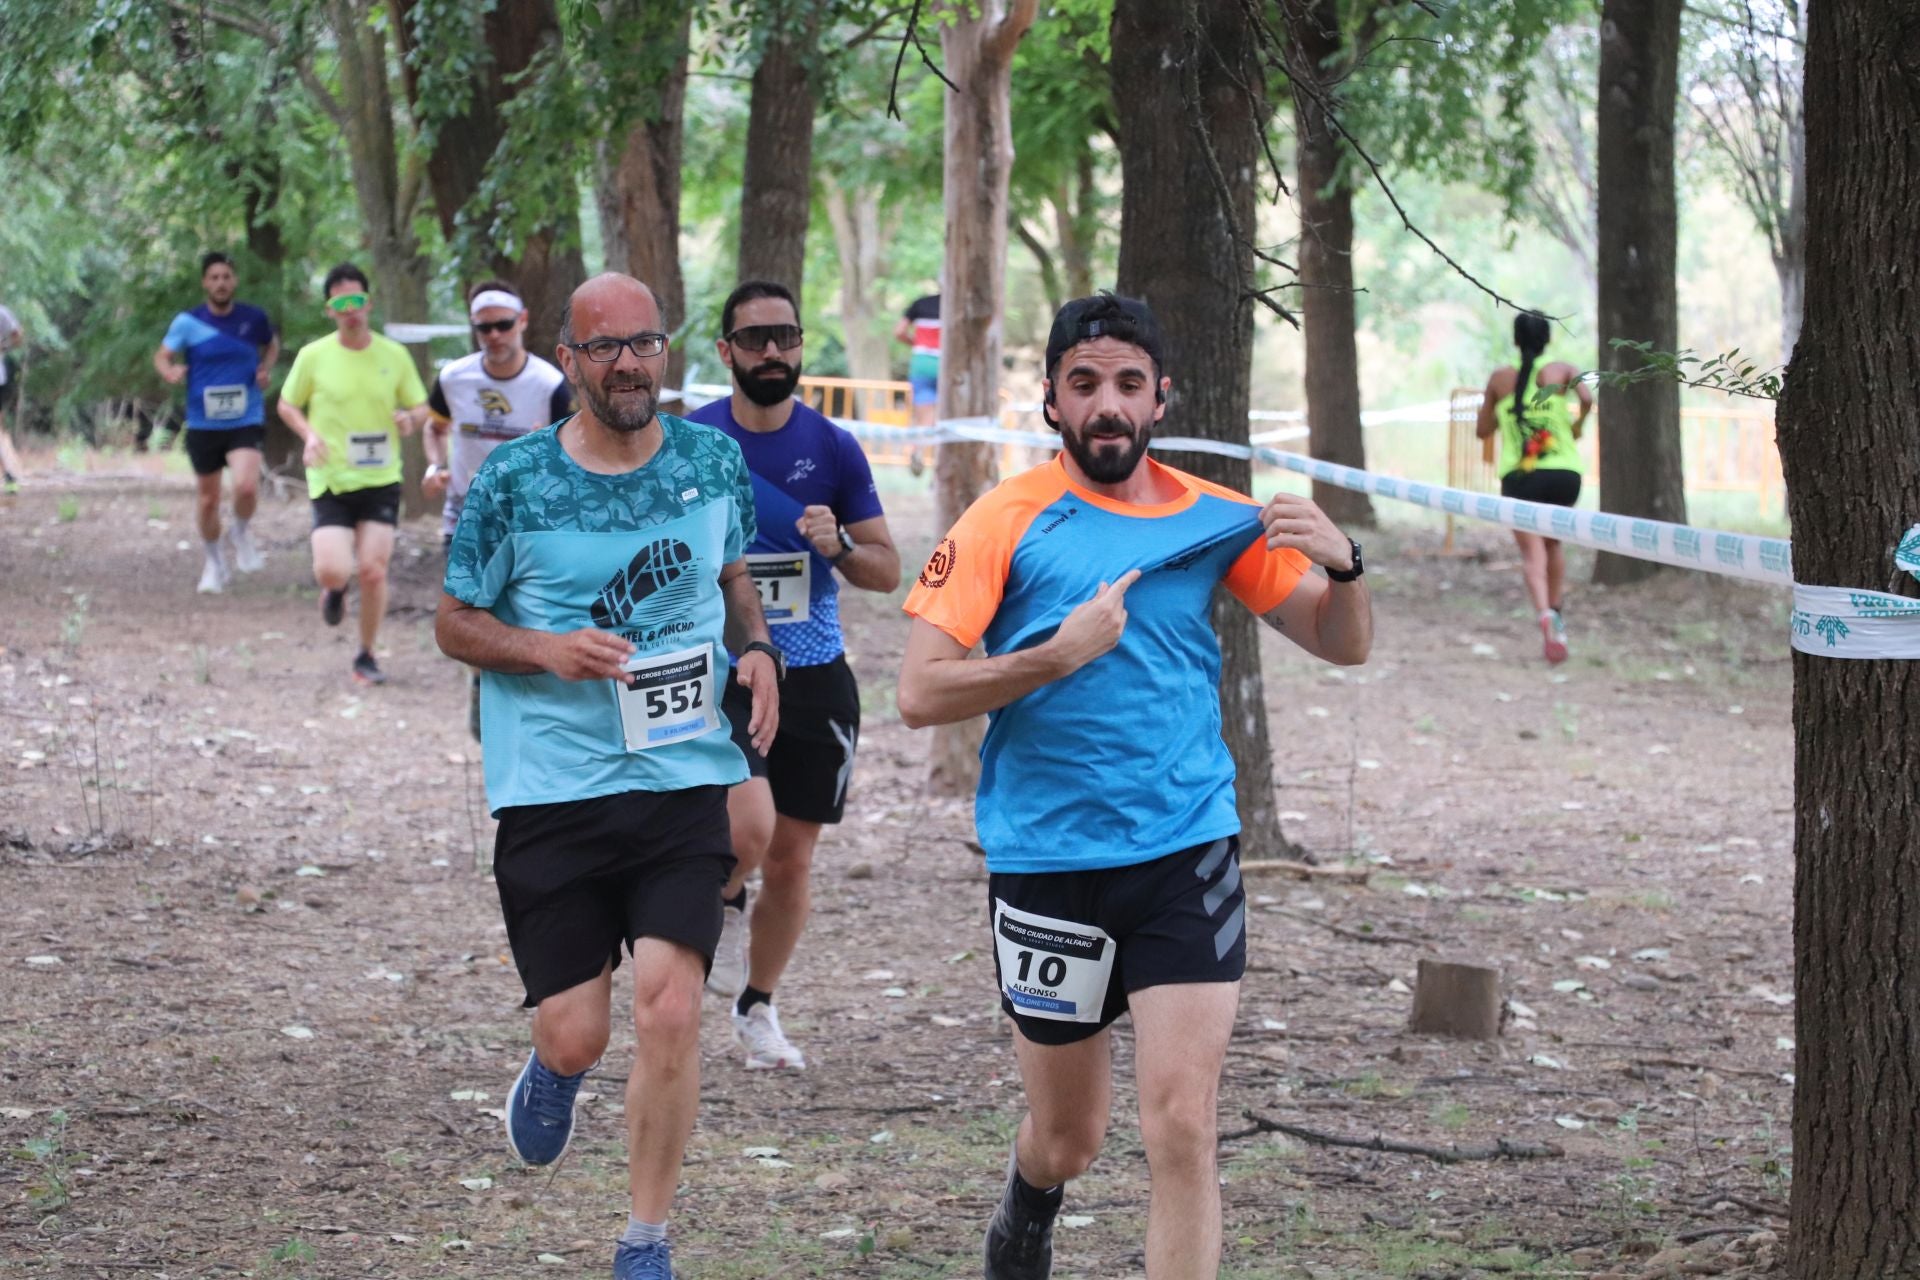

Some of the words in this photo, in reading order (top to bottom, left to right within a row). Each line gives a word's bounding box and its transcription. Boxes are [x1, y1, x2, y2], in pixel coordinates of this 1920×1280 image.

[641, 671, 661, 679] CROSS
[662, 666, 682, 675] CIUDAD
[646, 680, 702, 718] 552
[1007, 923, 1027, 935] CROSS
[1027, 930, 1053, 941] CIUDAD
[1065, 938, 1092, 948] ALFARO
[1018, 950, 1067, 987] 10
[1013, 983, 1057, 998] ALFONSO
